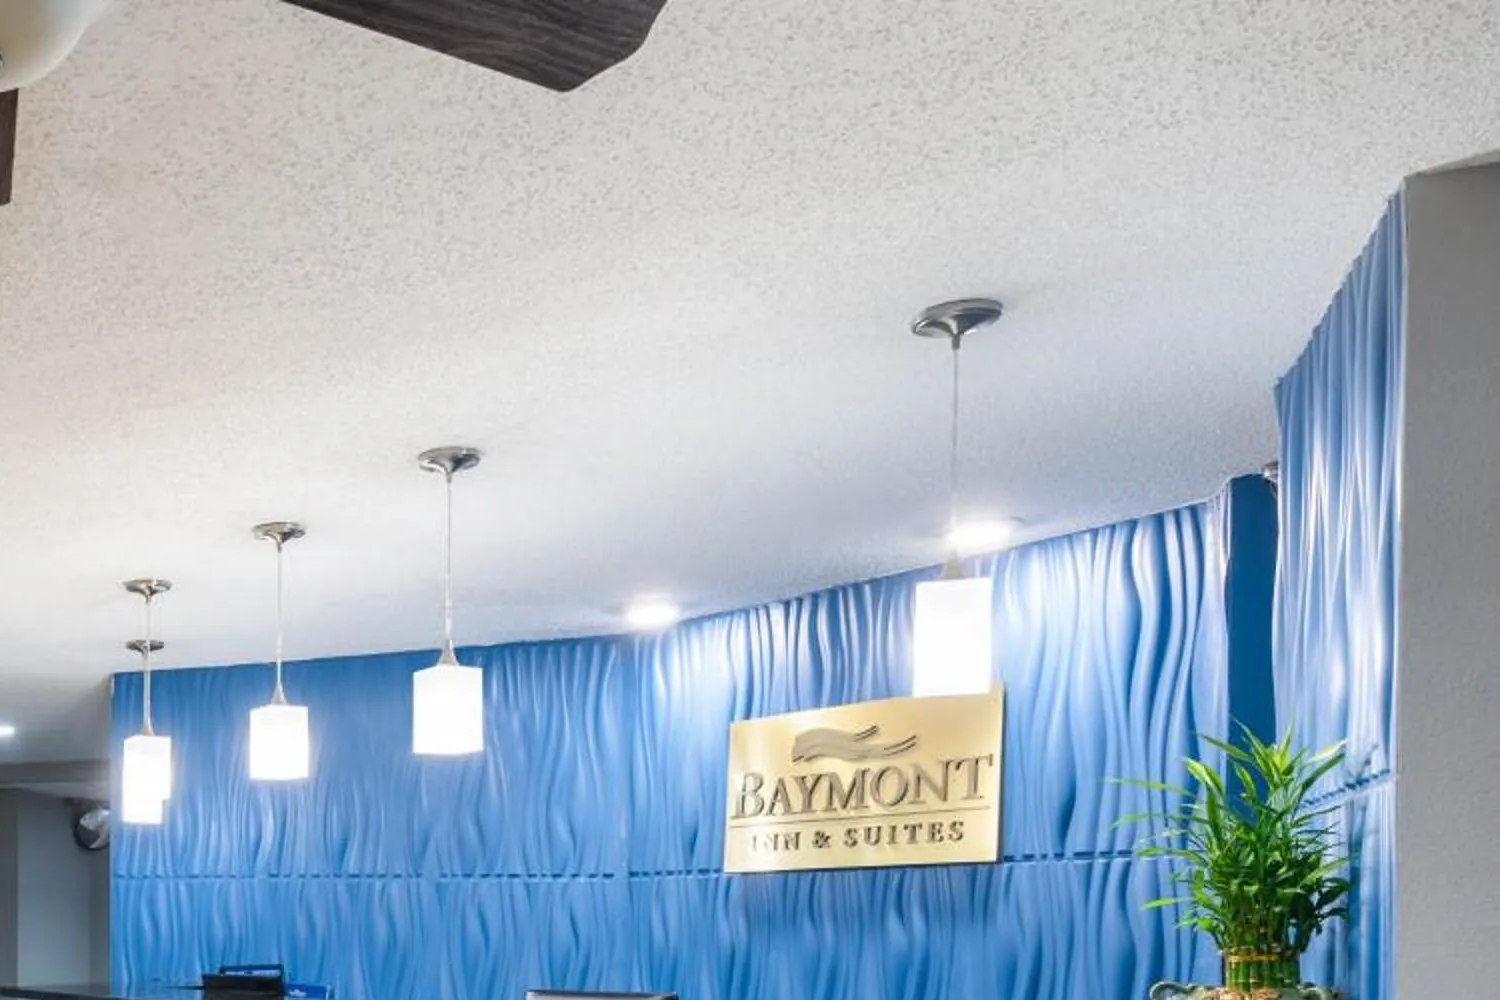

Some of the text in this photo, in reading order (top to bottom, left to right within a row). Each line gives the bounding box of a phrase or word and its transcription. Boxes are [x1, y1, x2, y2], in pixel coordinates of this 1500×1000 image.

[730, 753, 995, 819] BAYMONT
[752, 820, 966, 852] INN & SUITES
